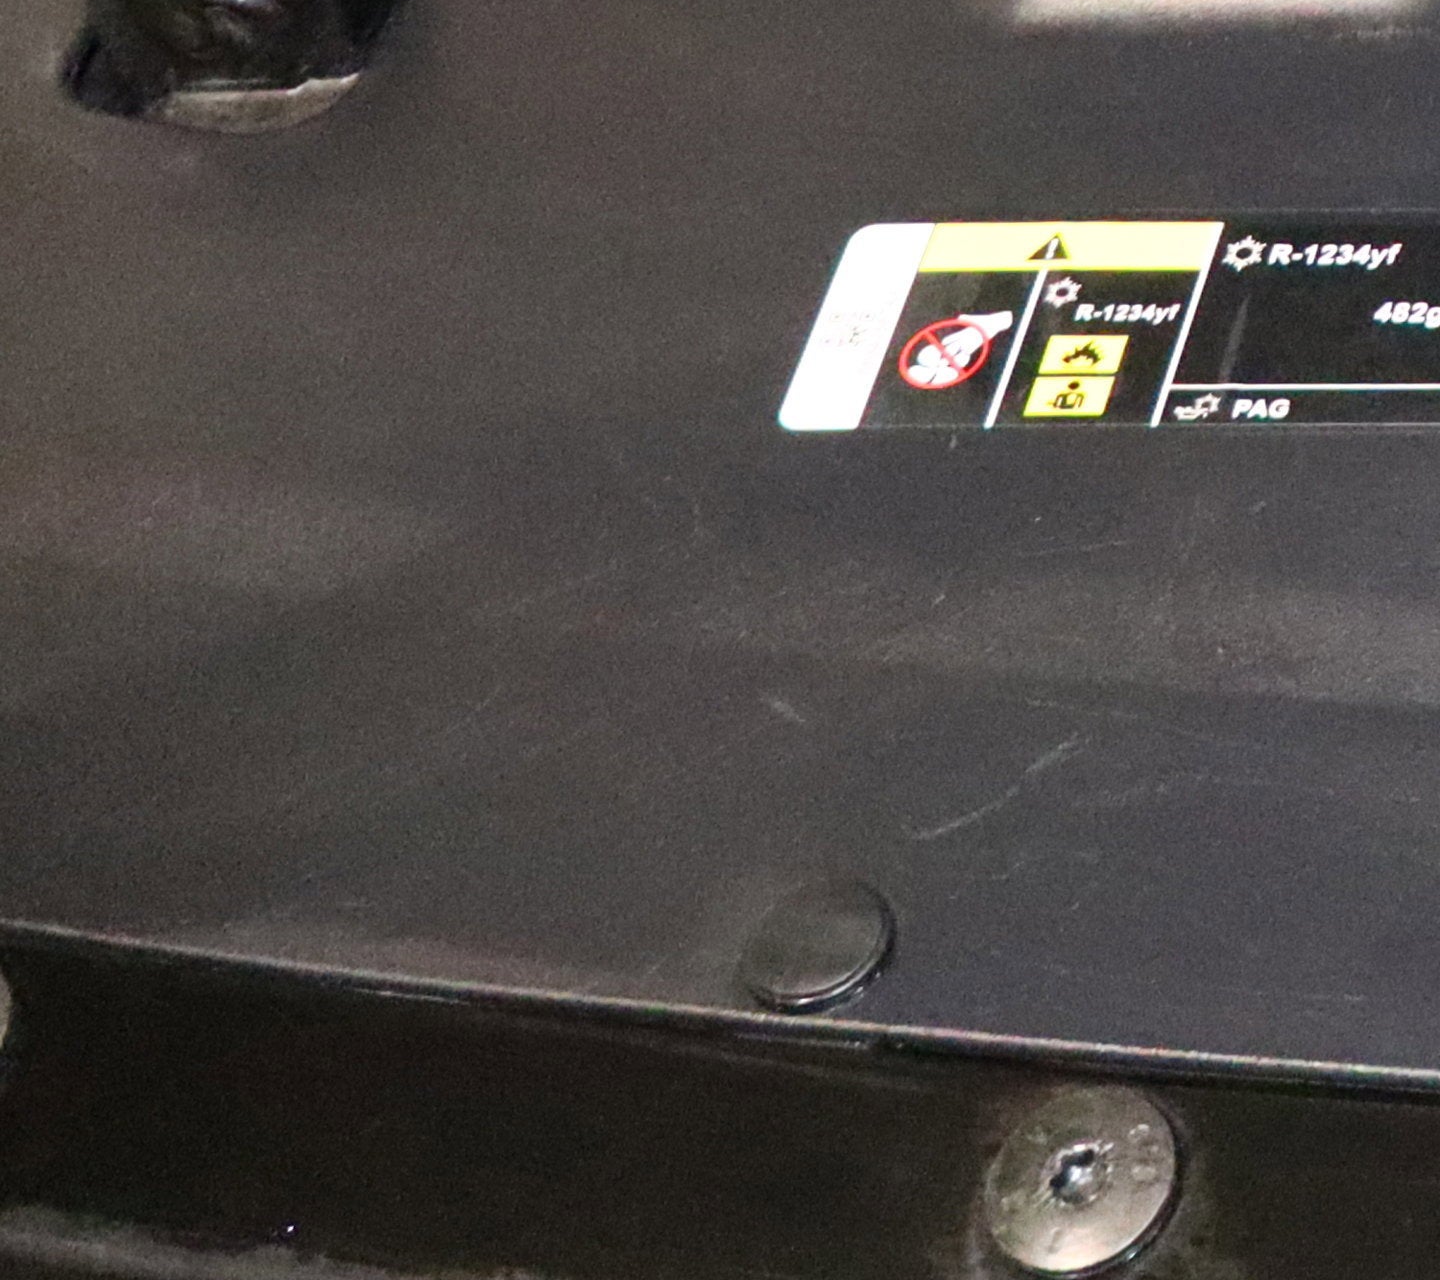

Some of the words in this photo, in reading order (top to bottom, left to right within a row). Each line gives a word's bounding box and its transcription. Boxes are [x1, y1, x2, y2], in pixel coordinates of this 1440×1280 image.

[1267, 243, 1402, 270] R-1234yf
[1074, 303, 1181, 325] R-1234yf
[1231, 399, 1291, 419] PAG
